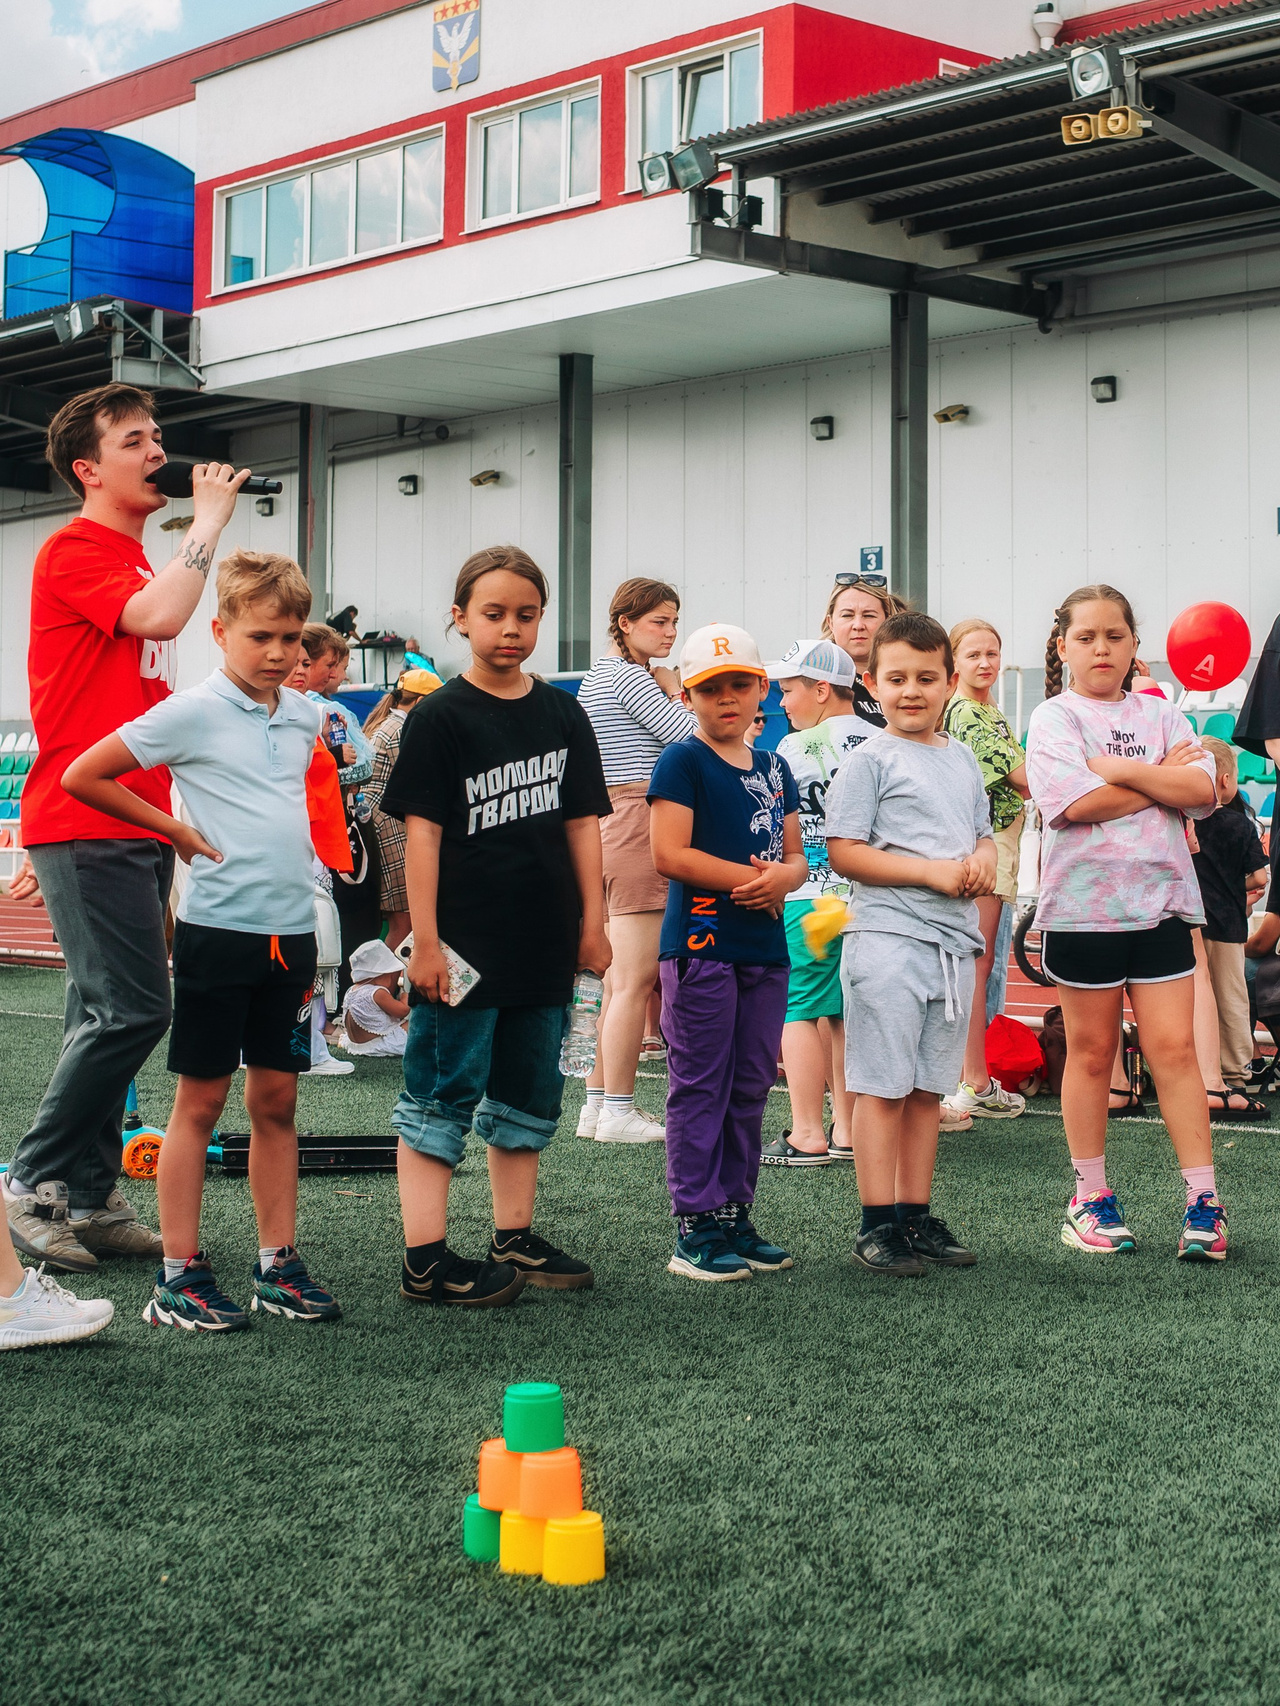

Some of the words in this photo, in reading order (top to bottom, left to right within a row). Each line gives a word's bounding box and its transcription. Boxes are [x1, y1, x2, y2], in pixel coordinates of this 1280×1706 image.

[867, 553, 876, 570] 3
[711, 636, 733, 656] R
[1106, 743, 1122, 756] THE
[467, 781, 562, 835] ГВАРДИ
[687, 895, 719, 950] NKS
